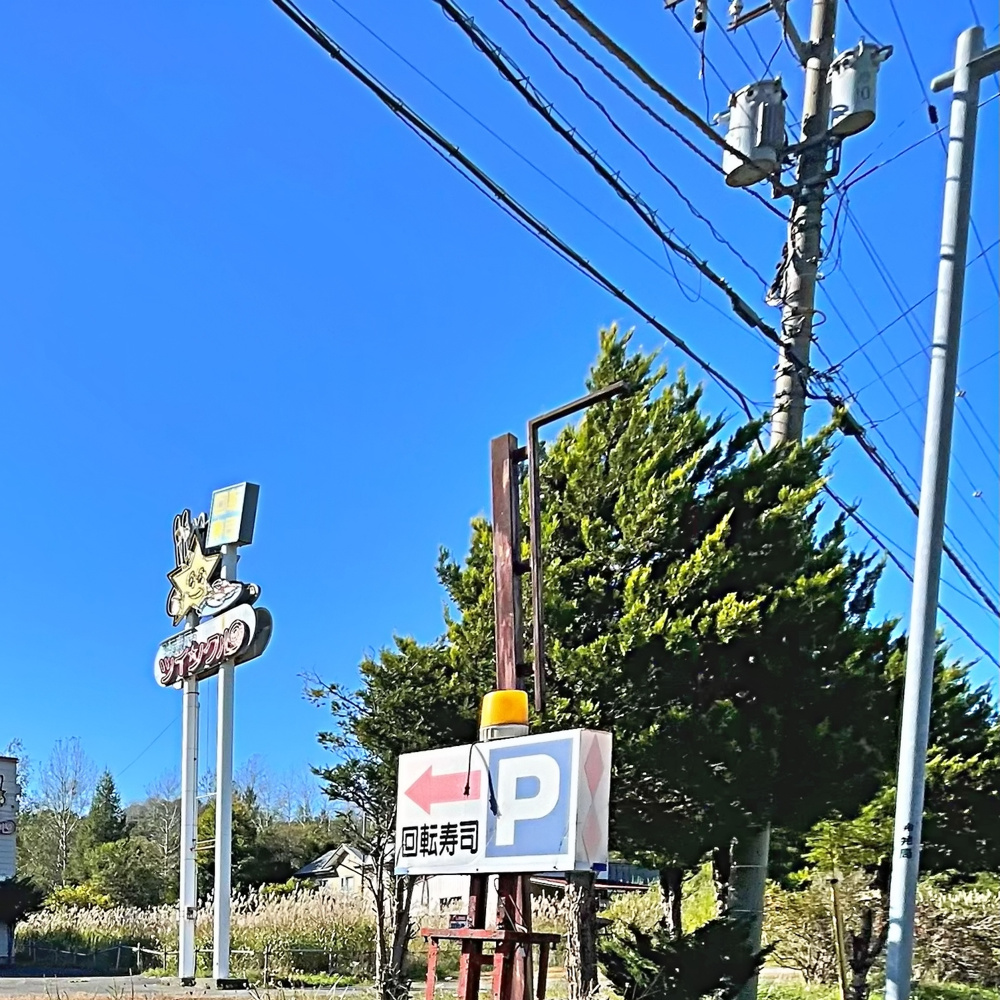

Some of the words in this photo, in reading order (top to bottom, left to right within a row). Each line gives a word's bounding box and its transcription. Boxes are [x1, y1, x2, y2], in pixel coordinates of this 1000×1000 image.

[495, 753, 560, 846] P
[401, 819, 479, 858] 回転寿司
